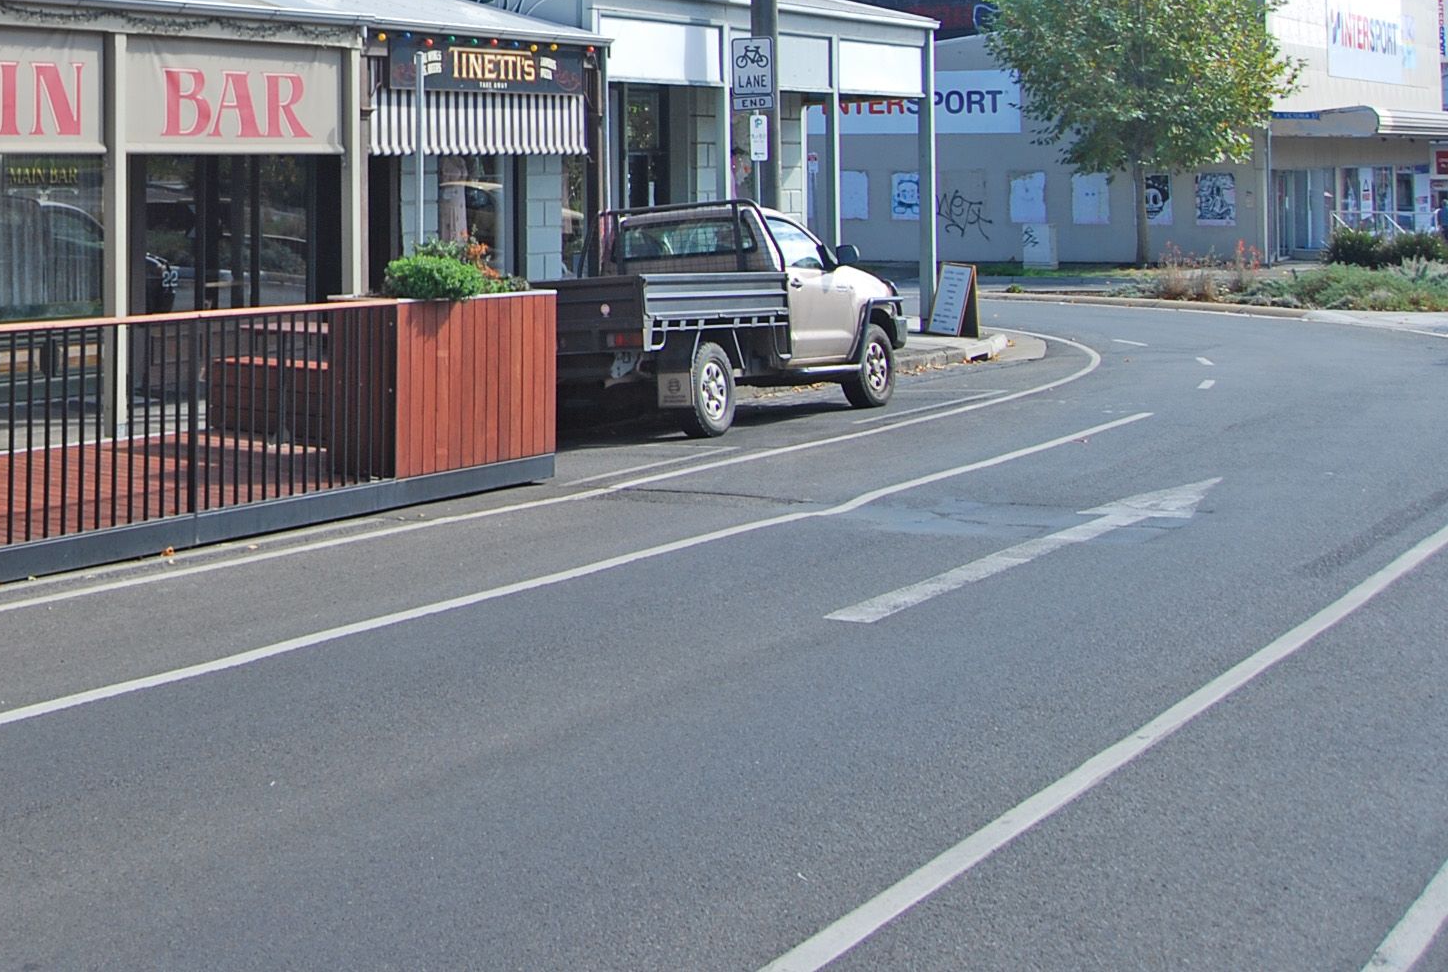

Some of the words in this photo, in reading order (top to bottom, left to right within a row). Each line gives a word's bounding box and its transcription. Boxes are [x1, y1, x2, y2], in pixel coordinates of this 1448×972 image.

[1340, 11, 1398, 56] INTERSPORT
[448, 46, 536, 82] TINETTI'S
[738, 74, 768, 88] LANE
[160, 67, 313, 139] BAR
[741, 98, 767, 108] END
[9, 166, 44, 185] MAIN
[49, 166, 79, 185] BAR
[162, 270, 179, 287] 22
